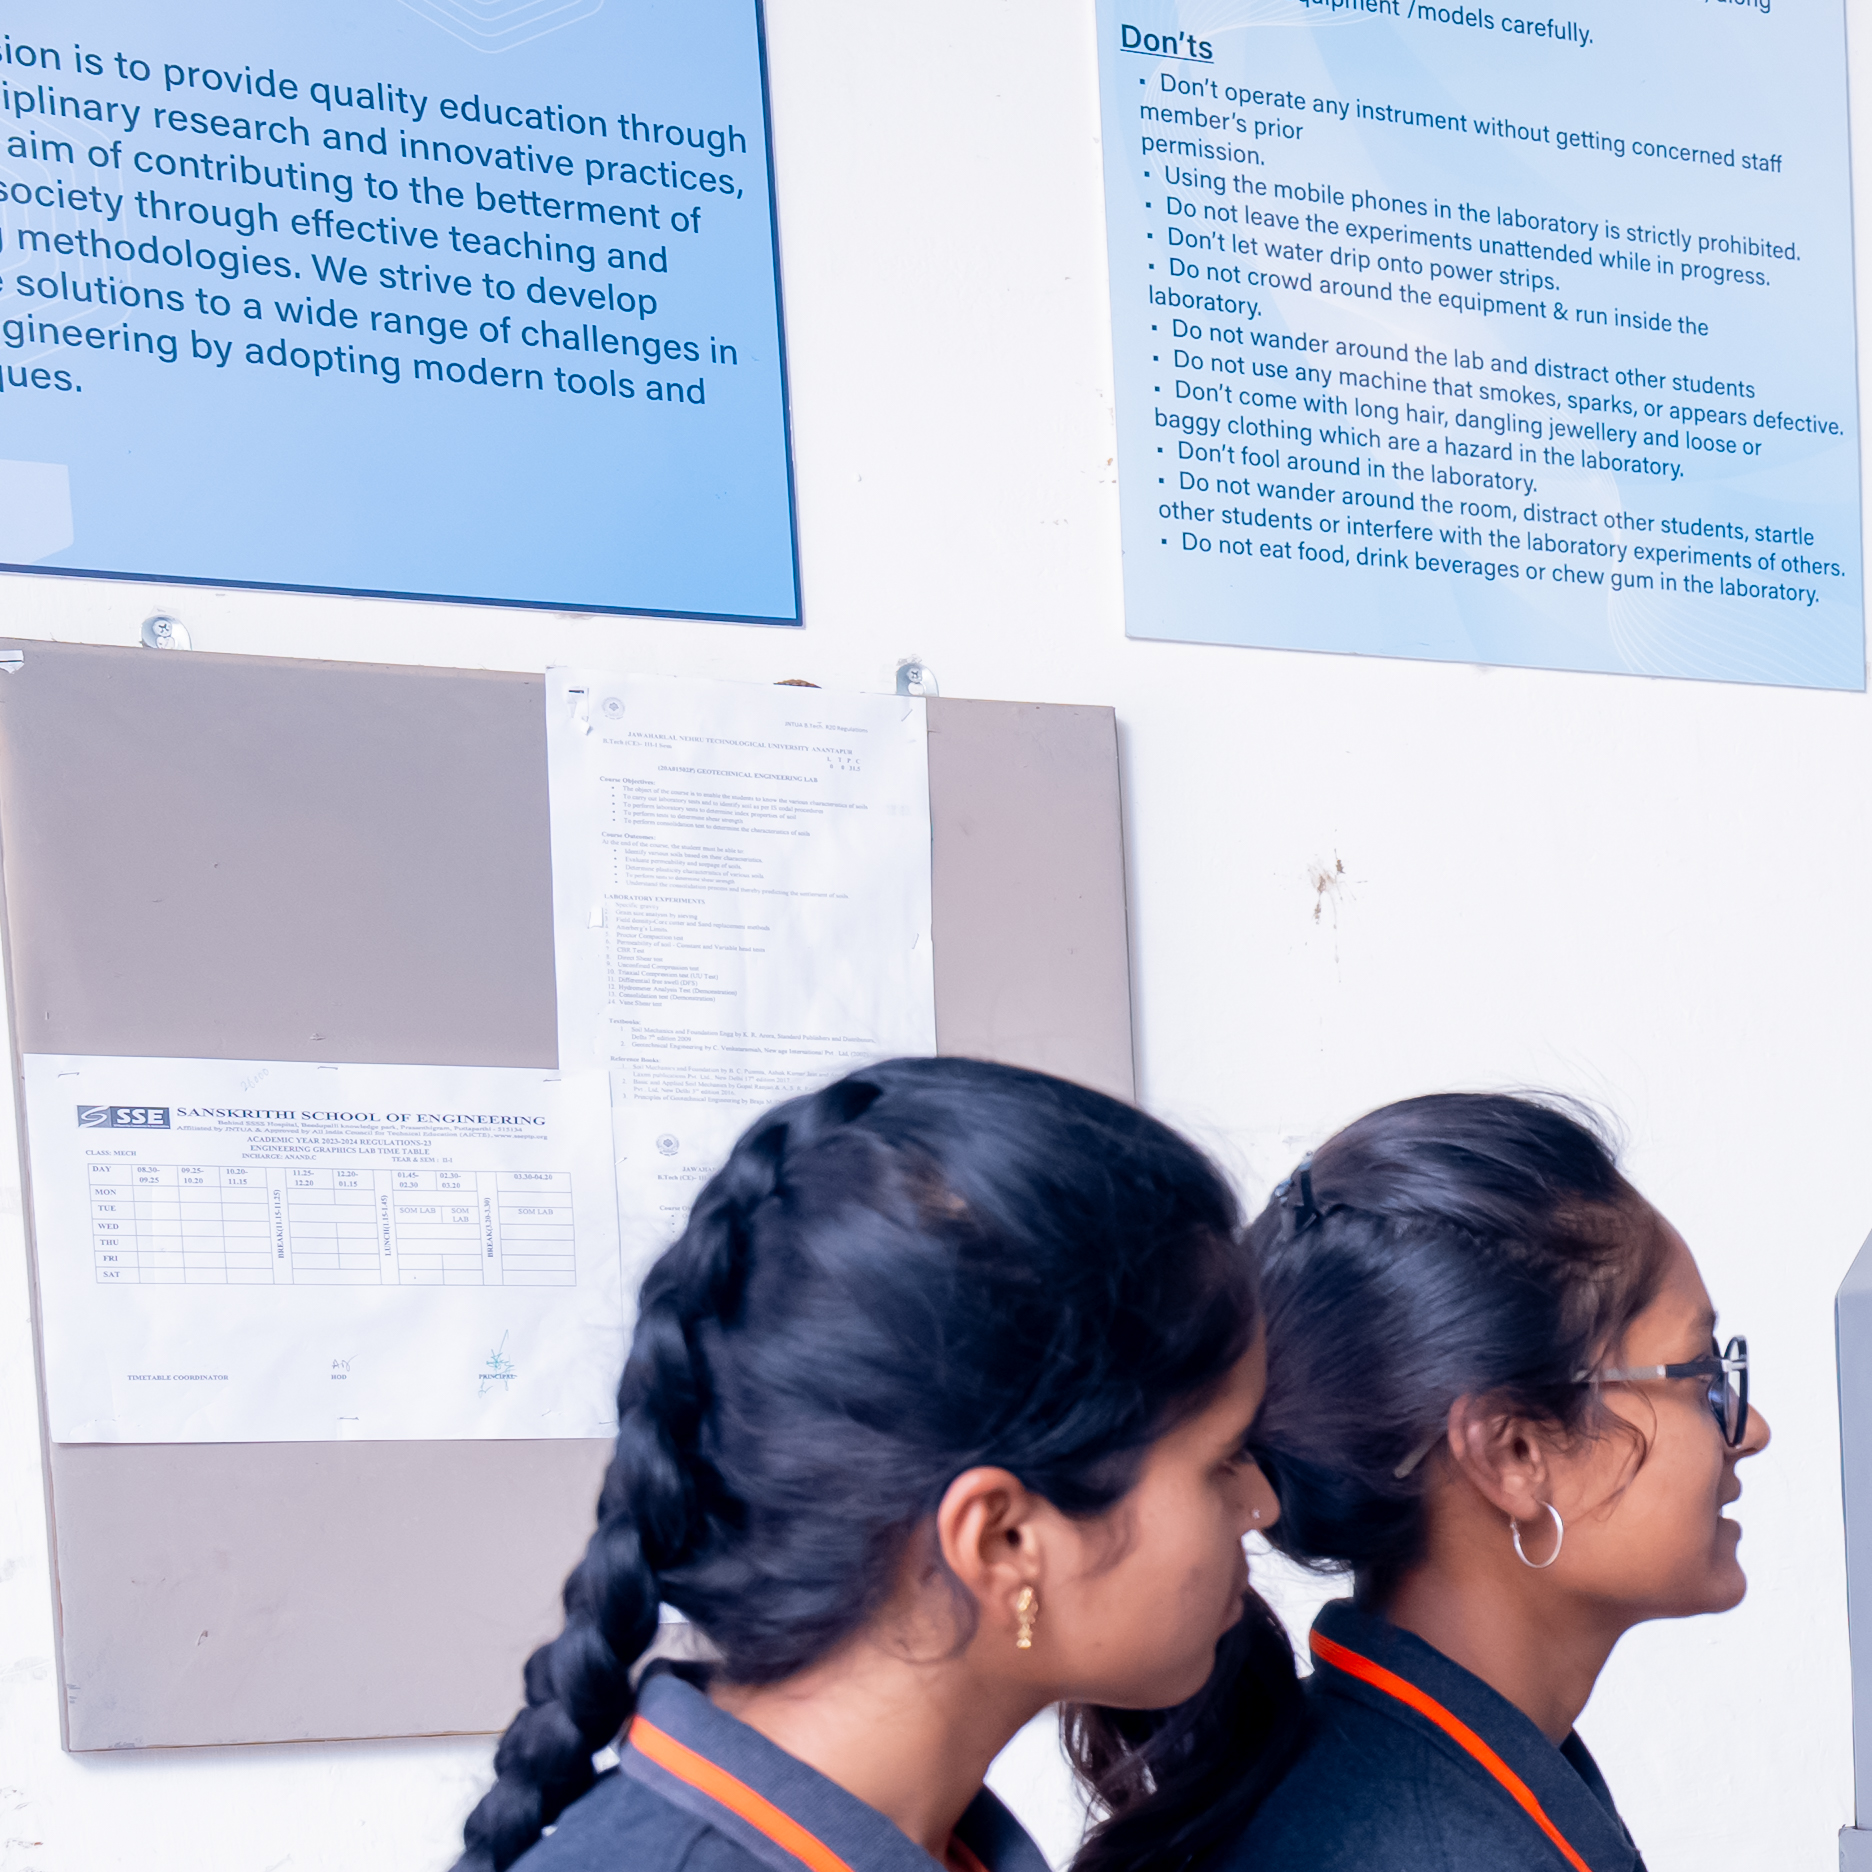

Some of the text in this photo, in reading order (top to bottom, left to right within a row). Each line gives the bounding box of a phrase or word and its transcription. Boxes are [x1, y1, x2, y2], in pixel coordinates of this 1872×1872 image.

[1120, 23, 1214, 60] Don'ts
[74, 43, 747, 158] is to provide quality education through
[7, 129, 702, 234] aim of contributing to the betterment of
[1164, 164, 1801, 262] Using the mobile phones in the laboratory is strictly prohibited.
[1167, 226, 1560, 294] Don't let water drip onto power strips.
[190, 328, 706, 405] by adopting modern tools and
[116, 1110, 166, 1125] SSE
[177, 1107, 546, 1126] SANSKRITHI SCHOOL OF ENGINEERING
[247, 1136, 320, 1145] ACADEMIC YEAR
[250, 1145, 429, 1156] ENGINEERING GRAPHICS LAB TIME TABLE
[92, 1165, 111, 1173] DAY
[95, 1188, 116, 1196] MON
[98, 1204, 116, 1212] TUE
[98, 1223, 119, 1231] WED
[103, 1270, 120, 1278] SAT
